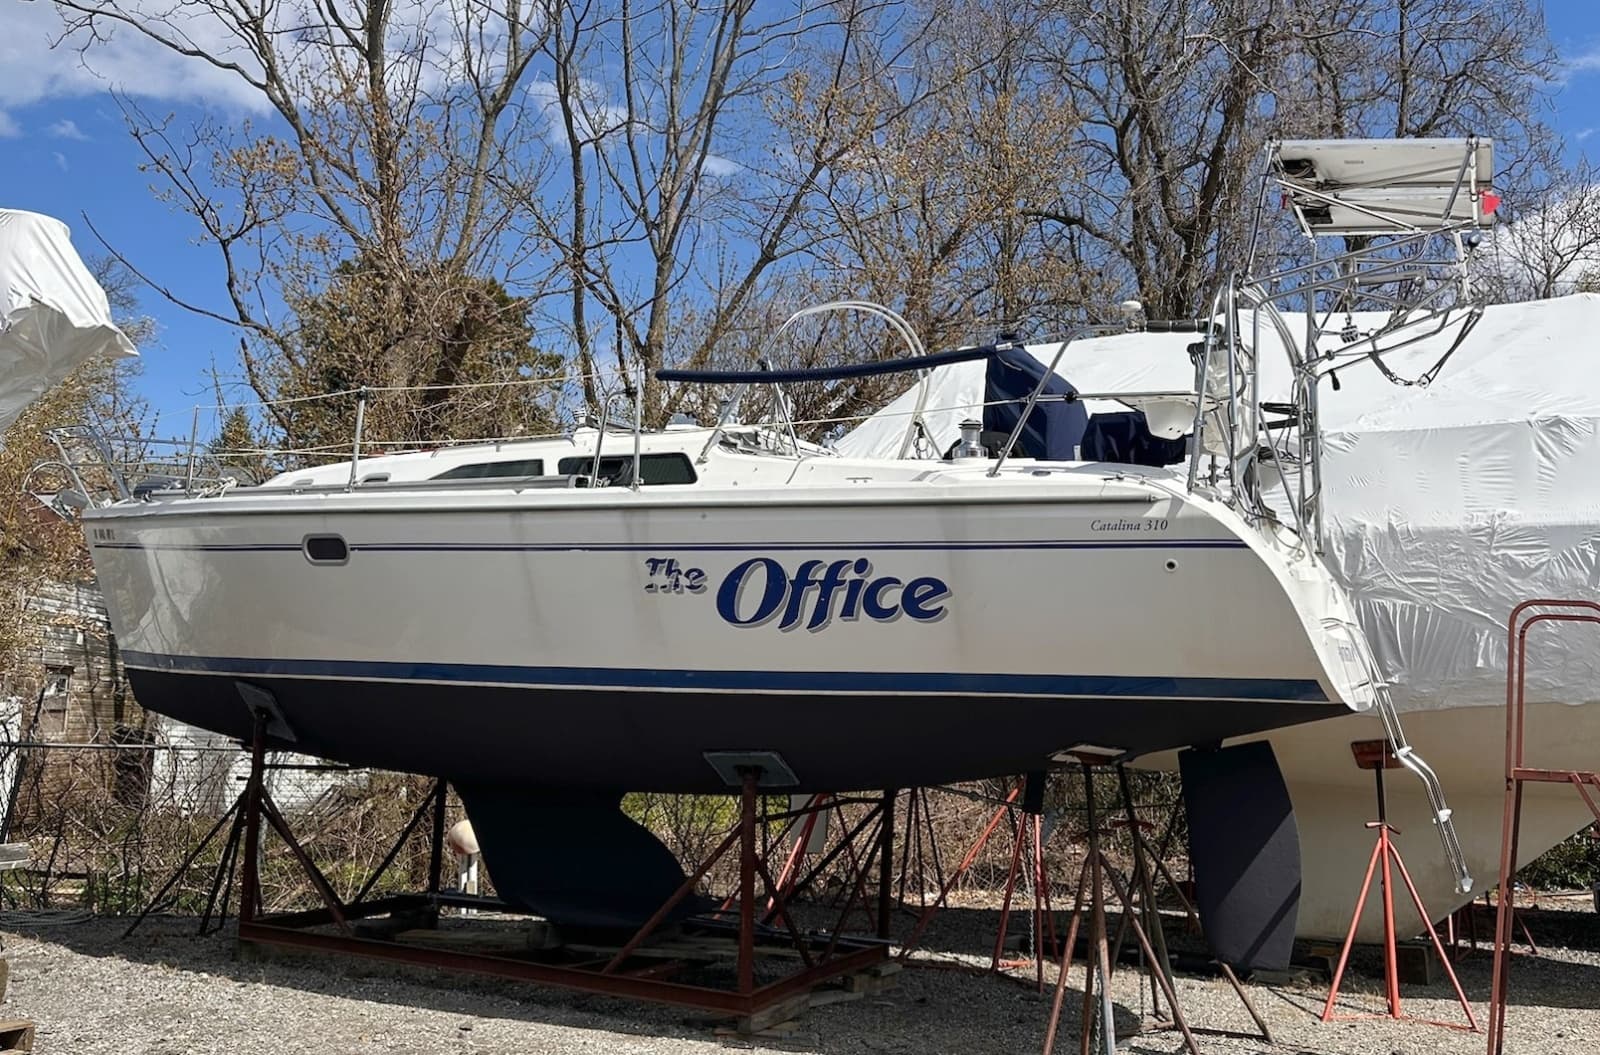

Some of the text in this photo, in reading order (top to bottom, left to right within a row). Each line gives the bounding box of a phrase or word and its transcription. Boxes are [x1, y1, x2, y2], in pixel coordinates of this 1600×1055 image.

[1090, 519, 1169, 532] Catalina 310
[644, 556, 953, 634] The Office
